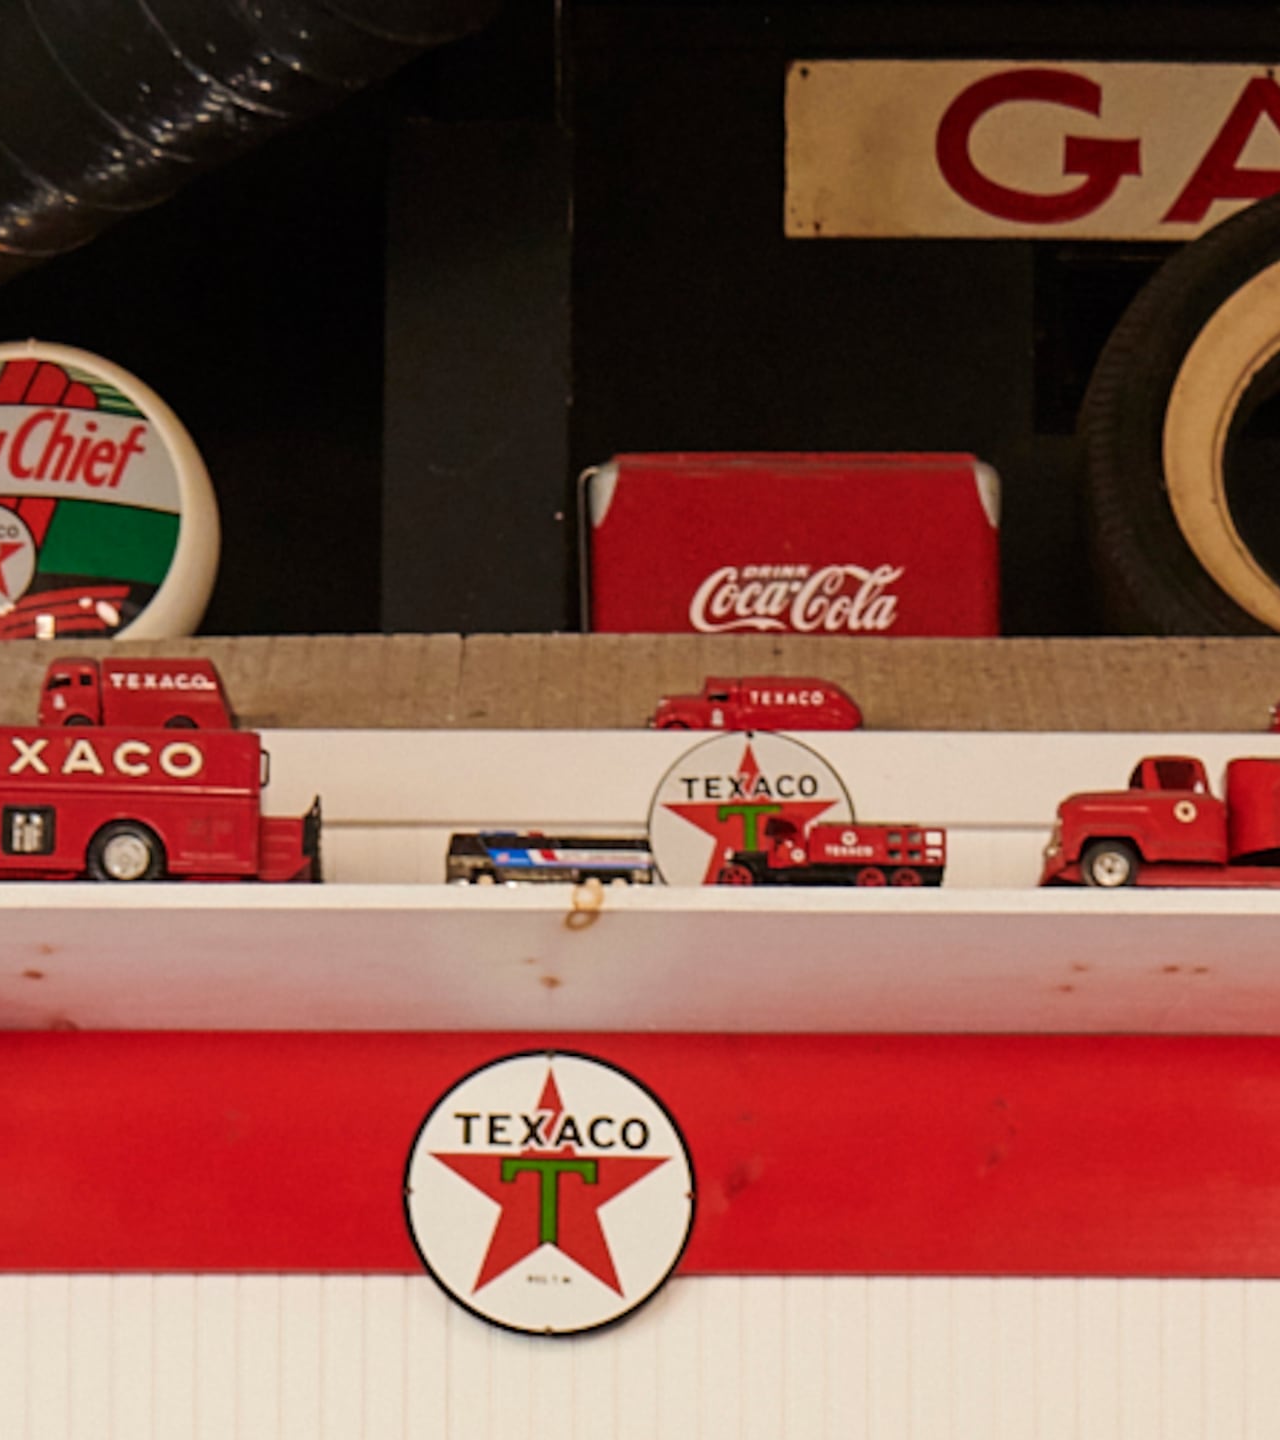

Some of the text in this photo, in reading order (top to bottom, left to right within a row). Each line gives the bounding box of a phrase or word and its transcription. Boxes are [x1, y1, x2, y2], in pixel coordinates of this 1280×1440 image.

[8, 408, 148, 489] Chief
[688, 563, 906, 633] Coca-Cola
[109, 672, 216, 691] TEXACO
[749, 690, 825, 706] TEXACO
[681, 774, 819, 801] TEXACO
[453, 1111, 651, 1151] TEXACO
